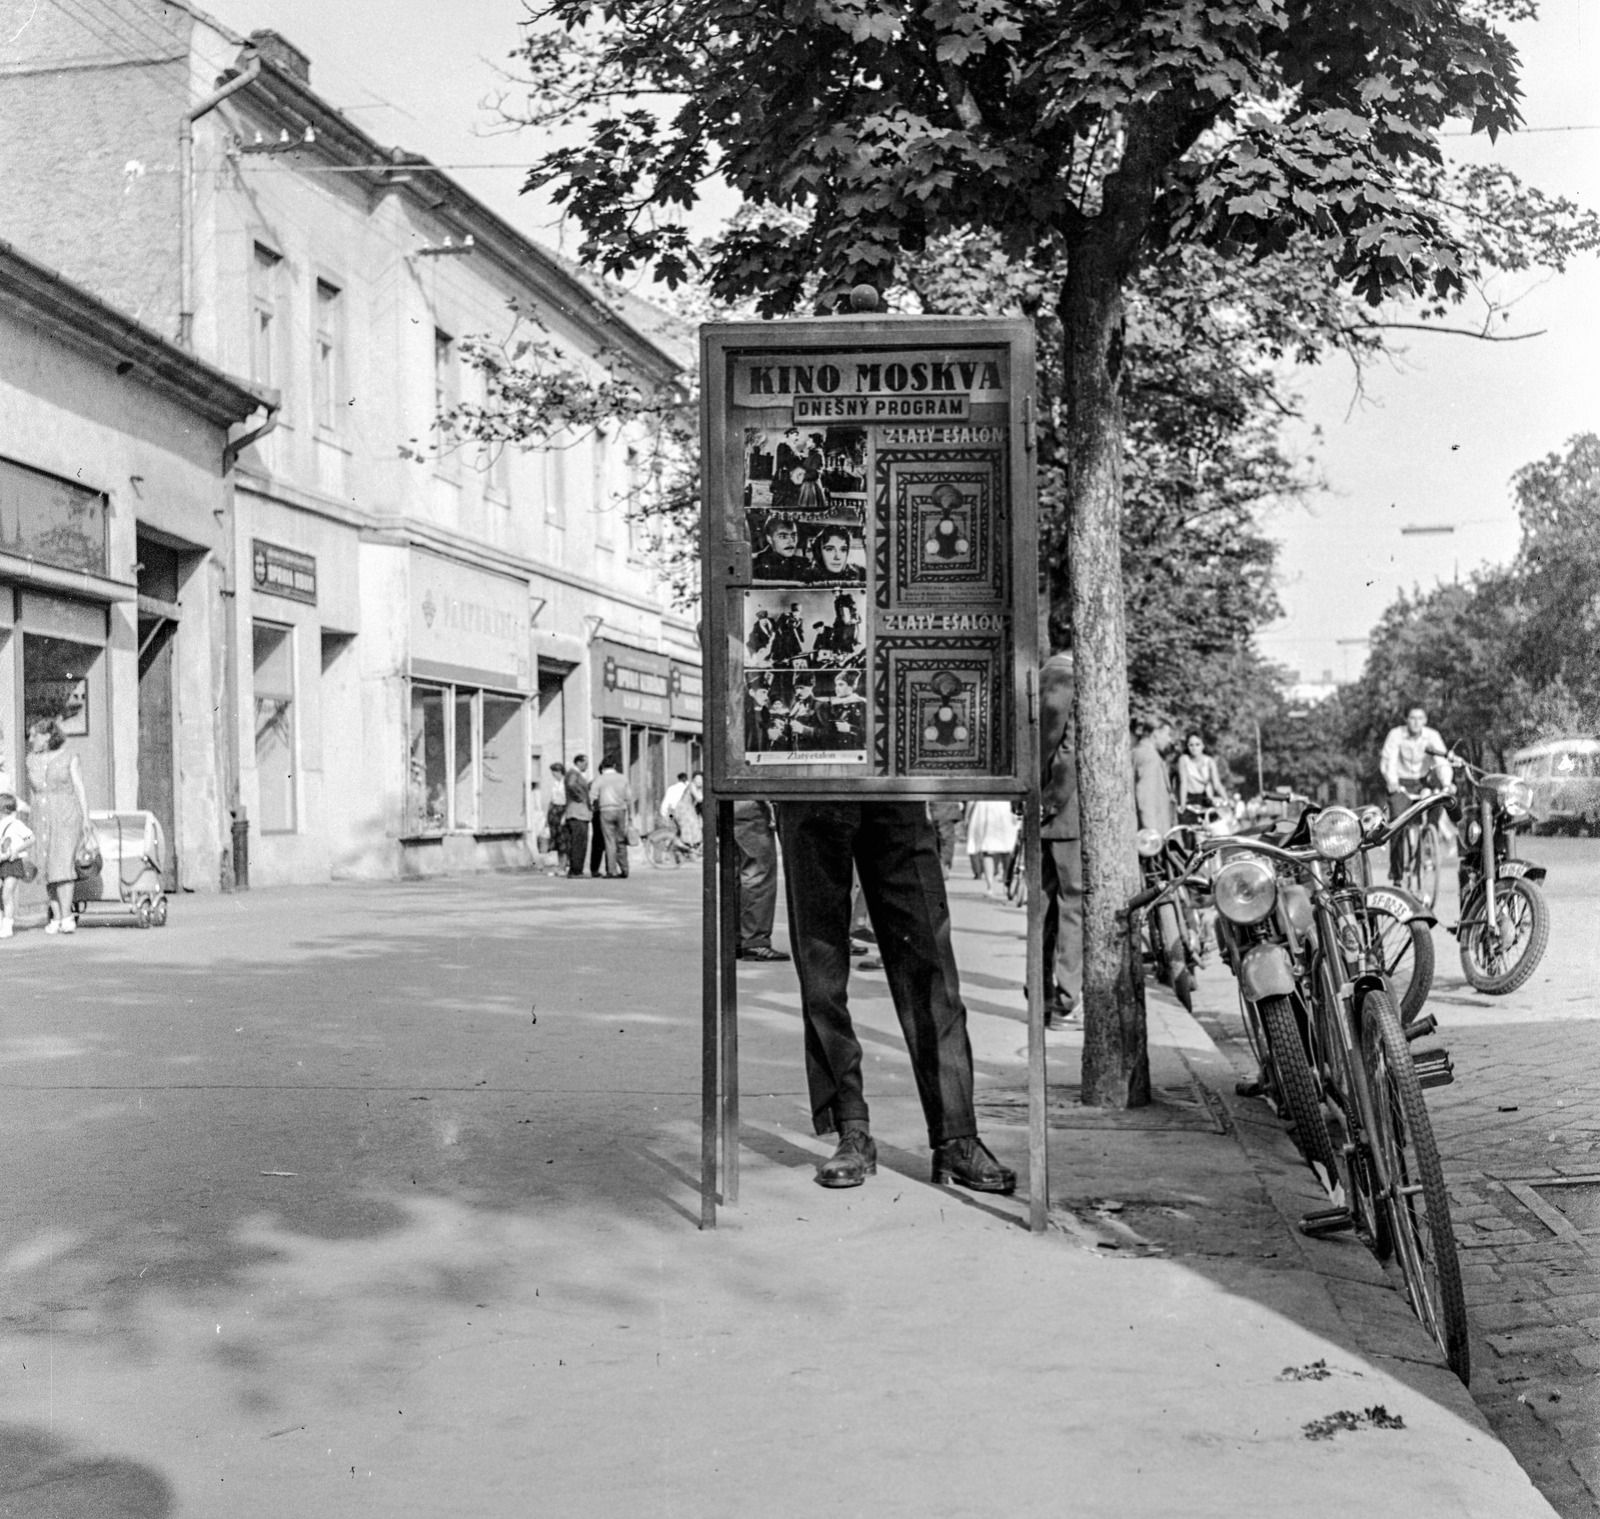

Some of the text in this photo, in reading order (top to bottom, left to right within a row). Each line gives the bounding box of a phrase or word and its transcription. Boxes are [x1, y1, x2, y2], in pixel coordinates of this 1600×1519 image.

[749, 360, 1003, 395] KINO MOSKVA
[799, 397, 963, 417] DNEŠNÝ PROGRAM
[885, 425, 1004, 444] ZLATÝ EŠALÓN
[885, 612, 1004, 631] ZLATÝ EŠALÓN
